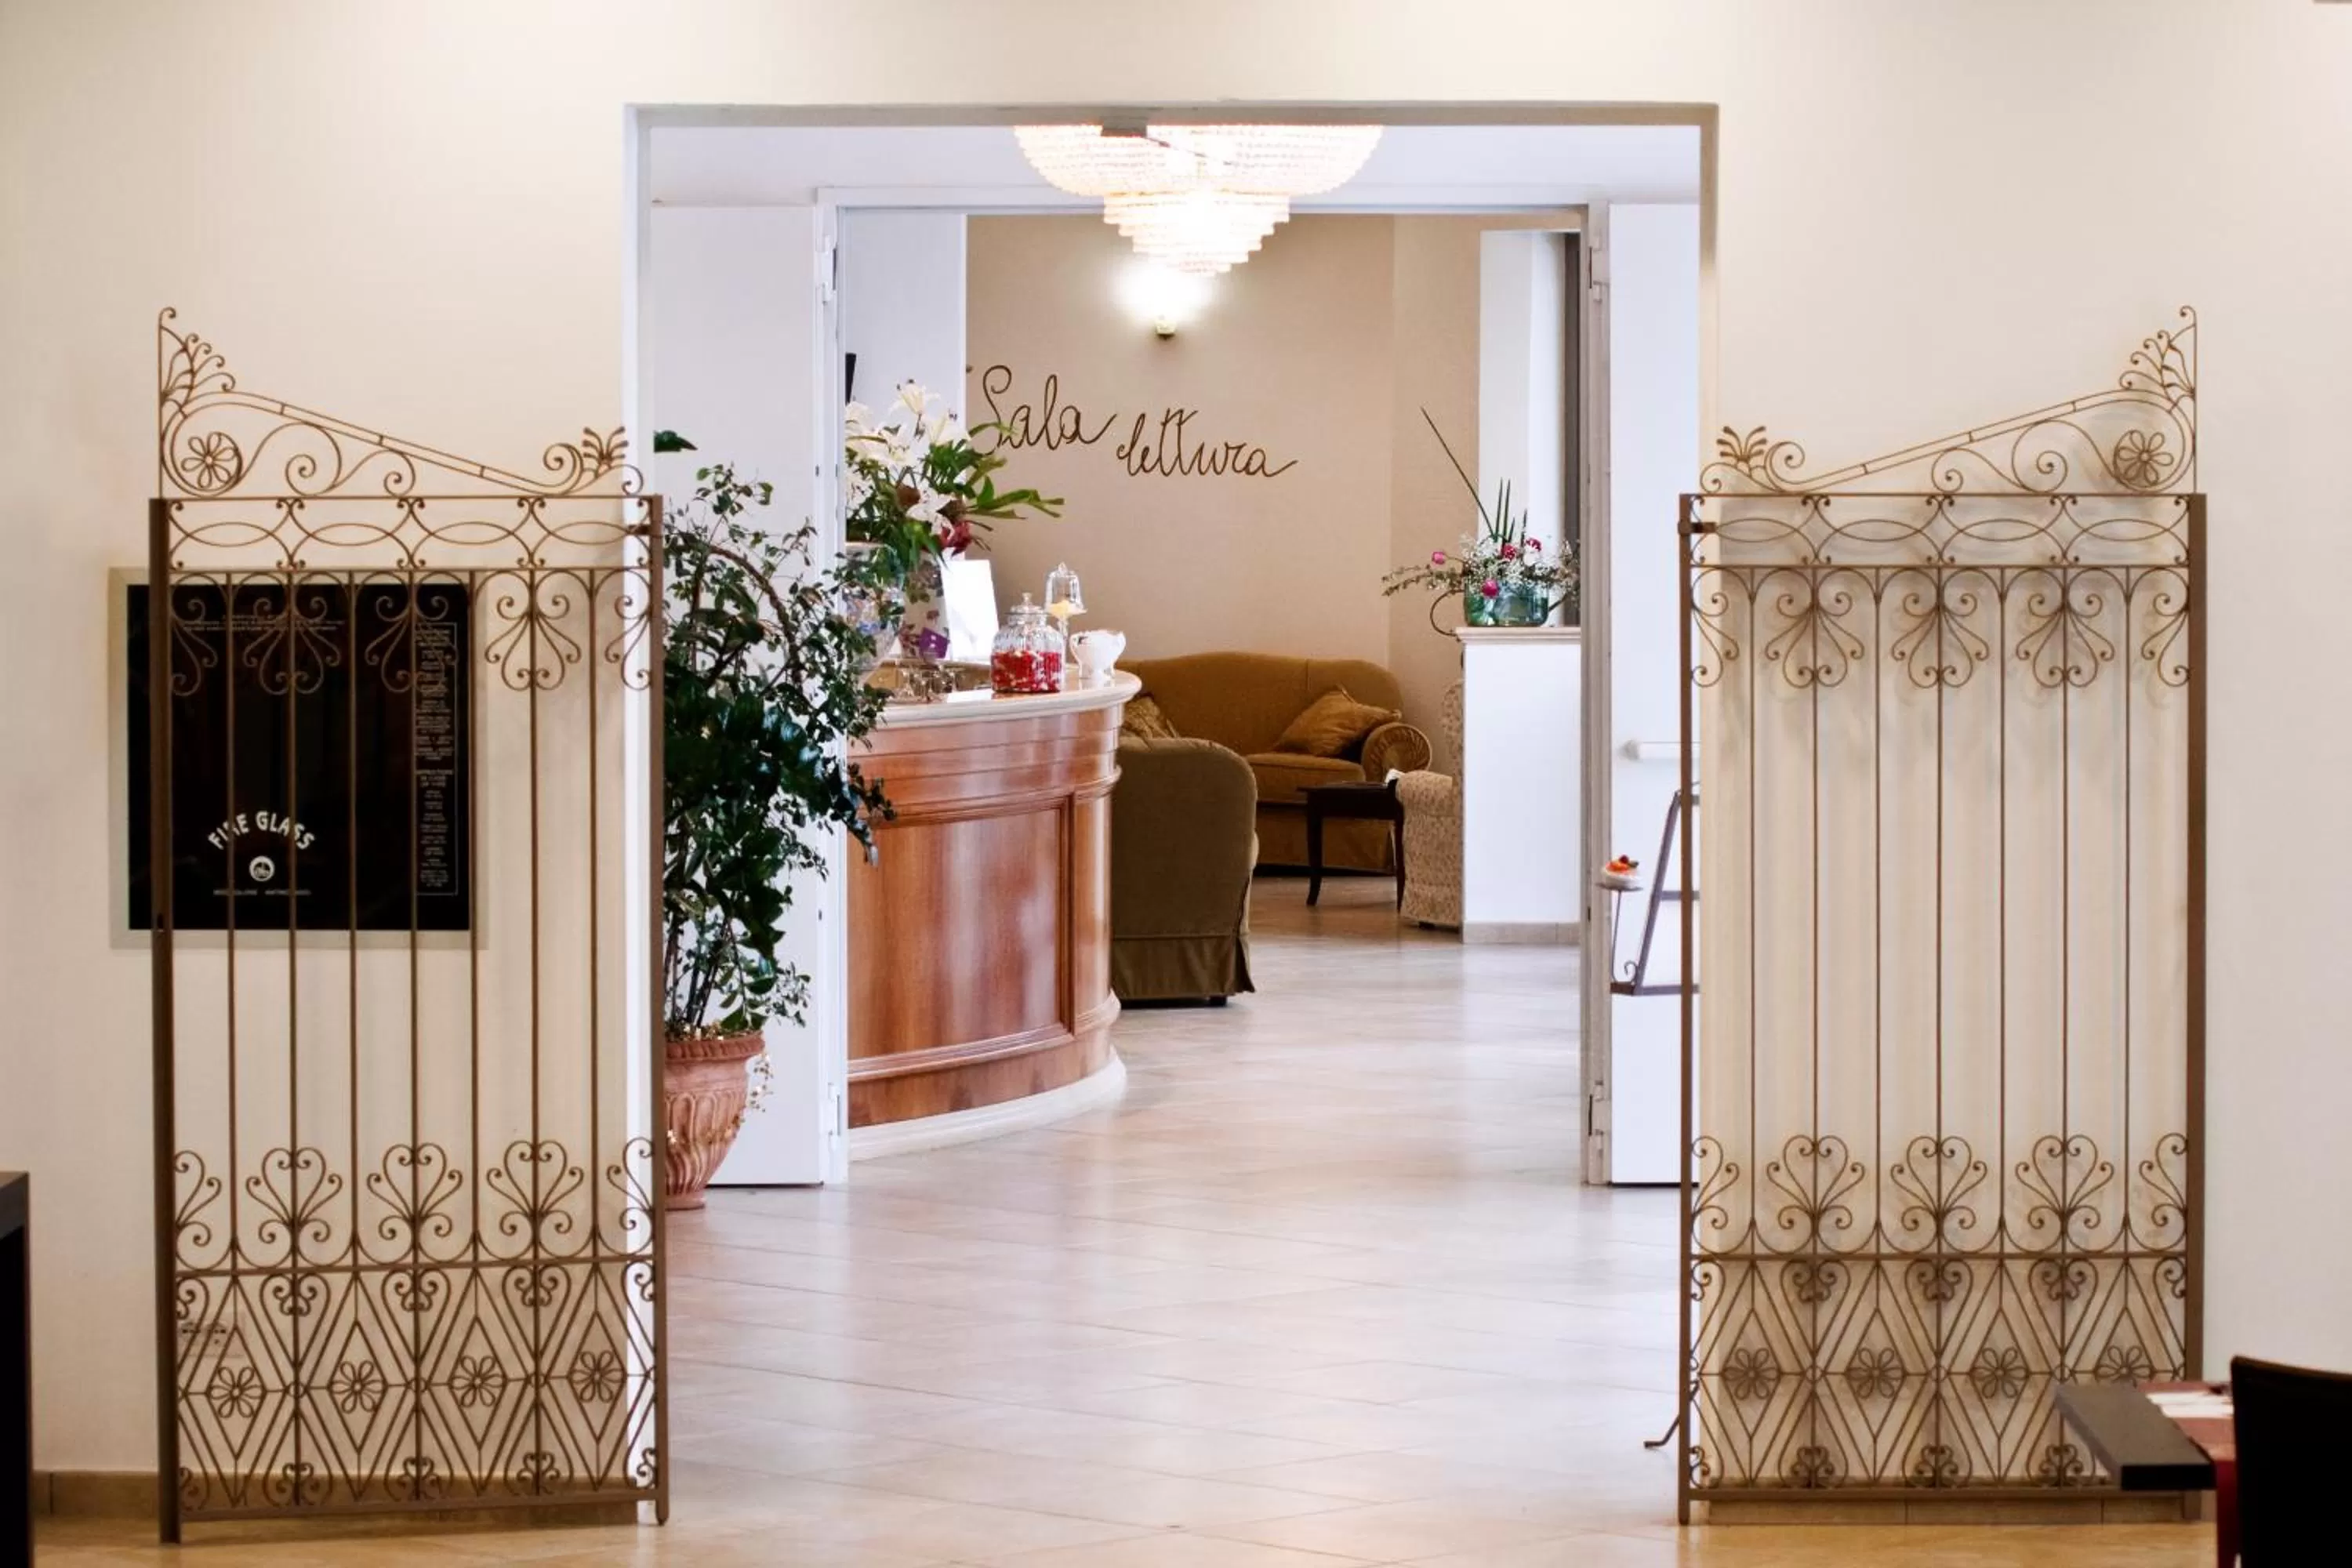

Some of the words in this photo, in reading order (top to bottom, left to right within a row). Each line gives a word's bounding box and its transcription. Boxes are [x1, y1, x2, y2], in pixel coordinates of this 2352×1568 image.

[975, 365, 1117, 456] Sala
[1116, 408, 1298, 477] lettura
[255, 810, 315, 851] GLASS
